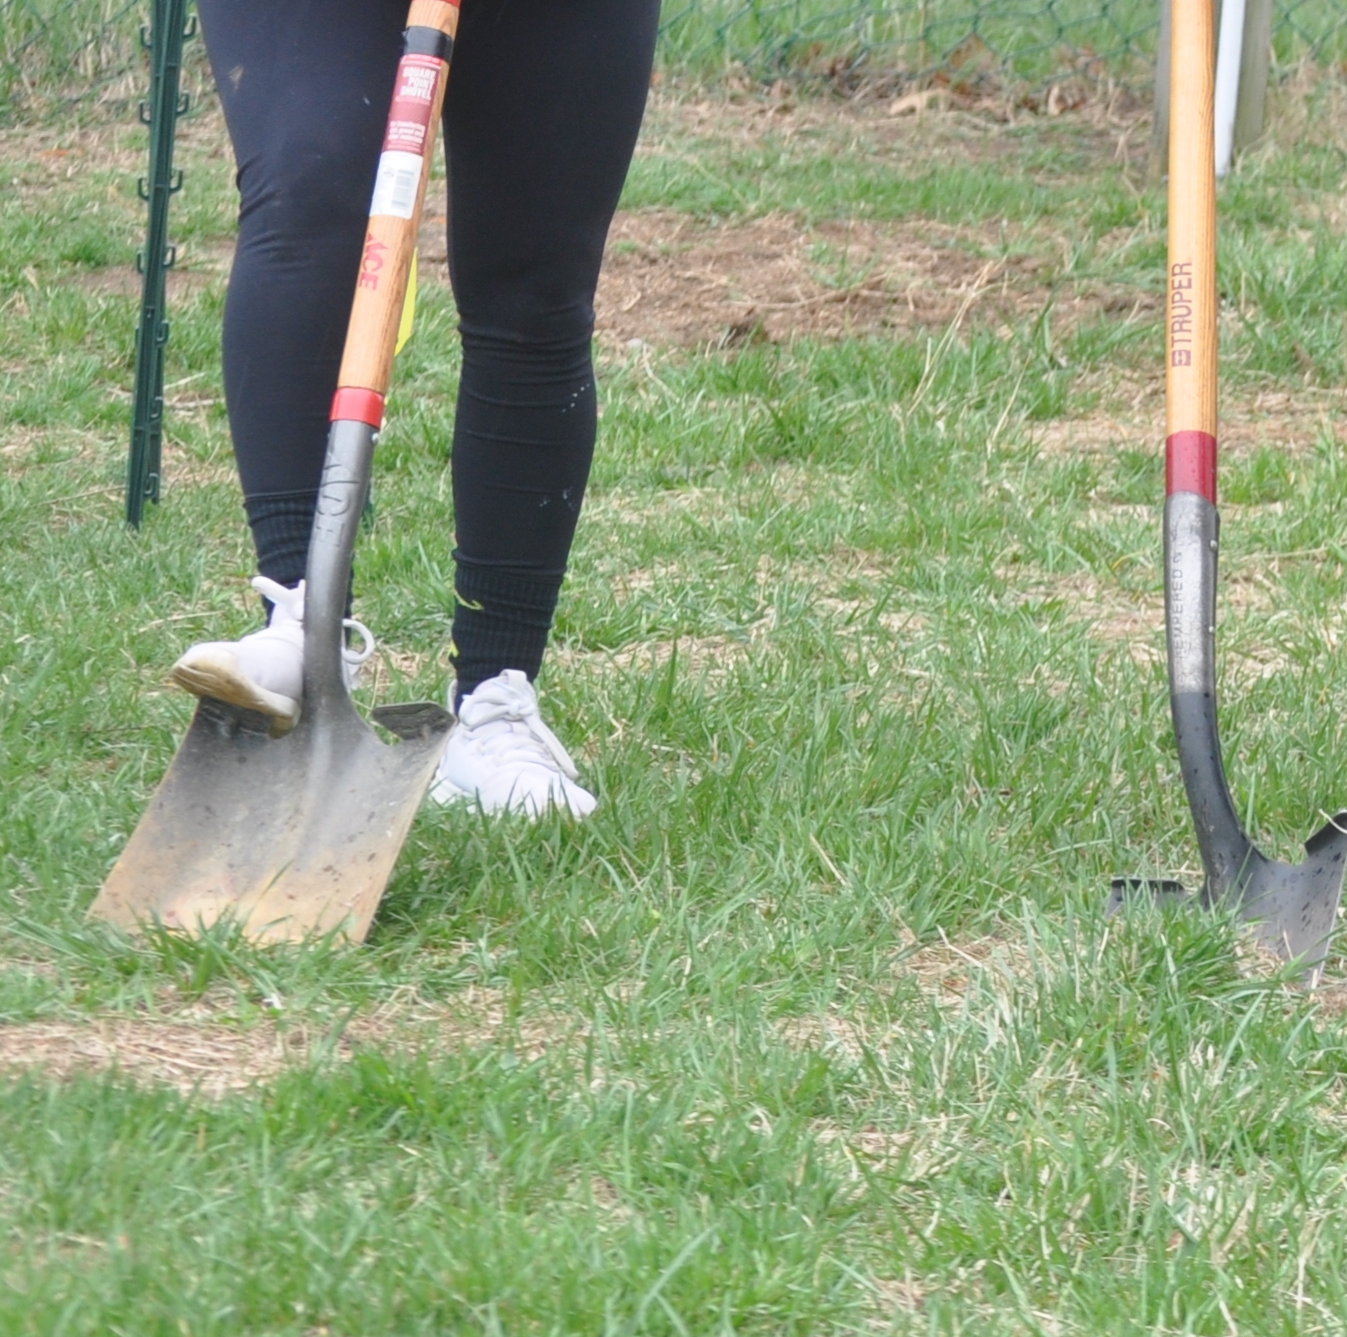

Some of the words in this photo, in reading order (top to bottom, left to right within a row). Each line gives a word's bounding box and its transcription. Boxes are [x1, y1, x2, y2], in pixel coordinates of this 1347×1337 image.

[402, 66, 437, 80] SQUARE
[408, 76, 435, 90] POINT
[400, 85, 432, 100] SHOVEL
[359, 232, 389, 291] ACE
[1171, 261, 1193, 349] TRUPER
